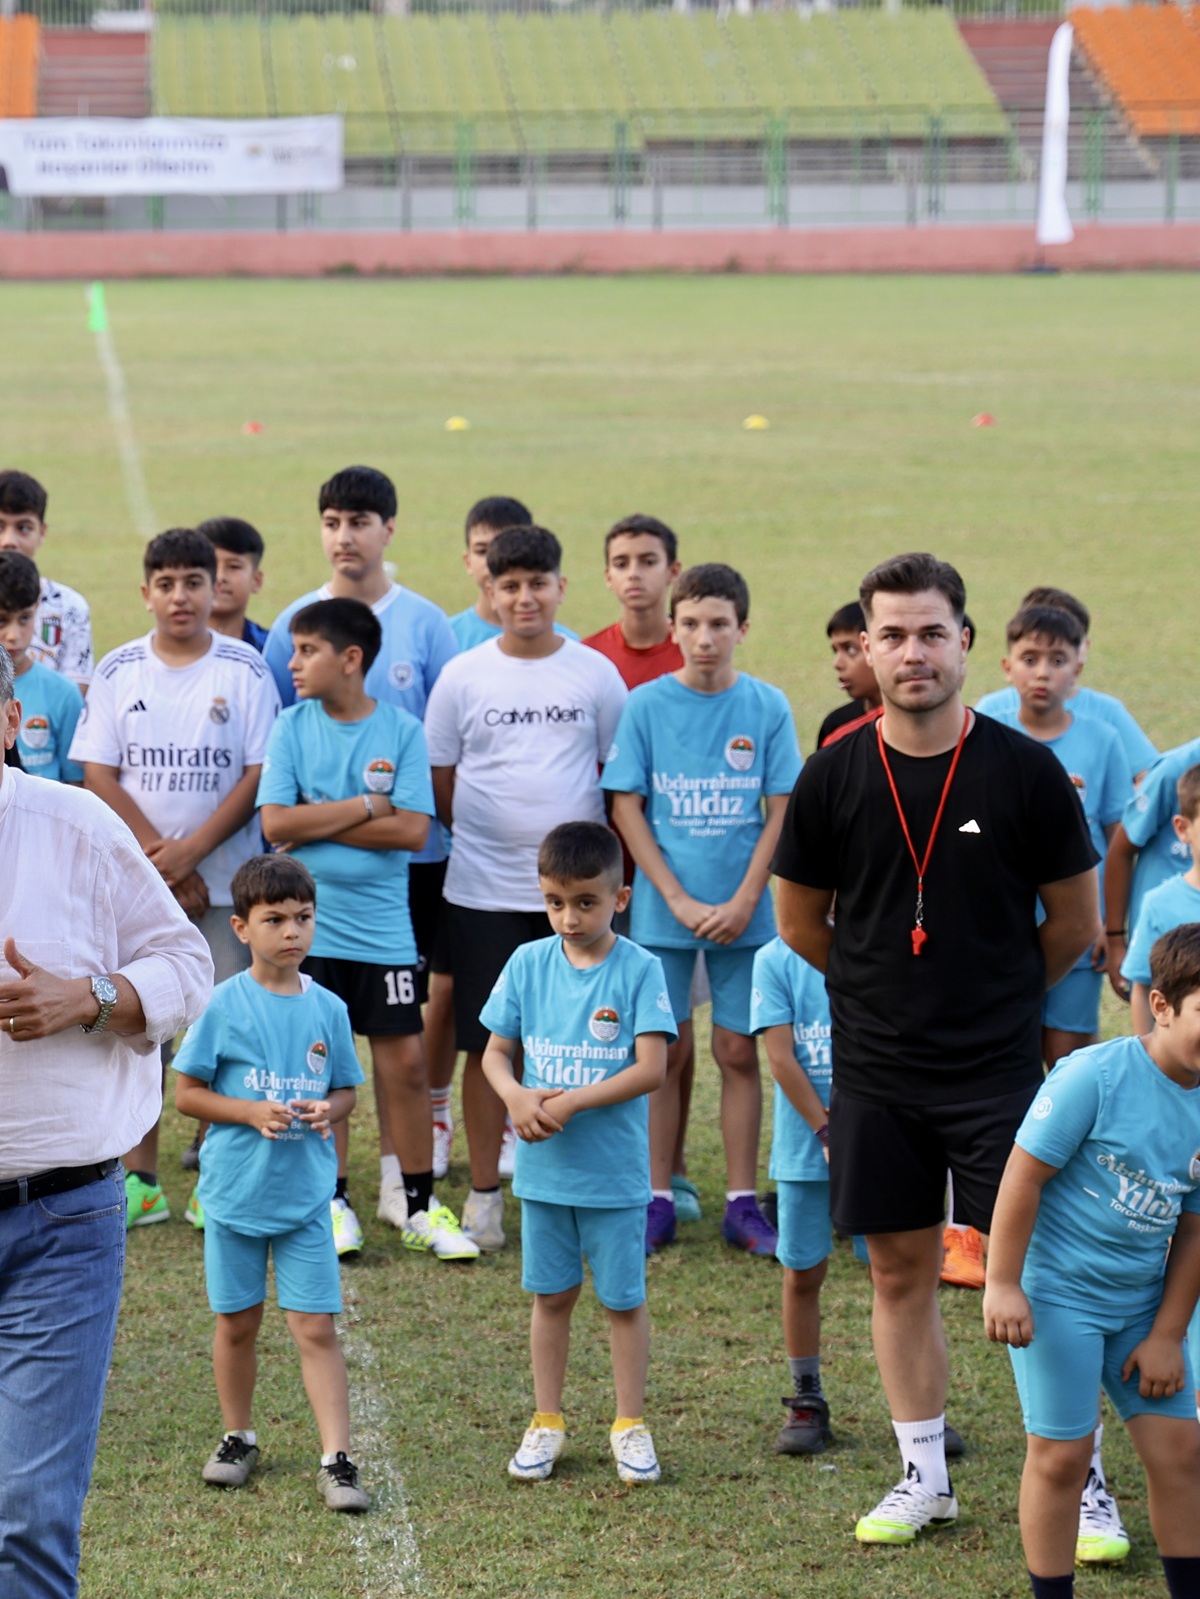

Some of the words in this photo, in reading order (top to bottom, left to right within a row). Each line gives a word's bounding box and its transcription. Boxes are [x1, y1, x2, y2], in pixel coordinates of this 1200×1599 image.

[545, 706, 586, 723] Klein
[127, 743, 233, 768] Emirates
[141, 772, 164, 792] FLY
[168, 772, 220, 793] BETTER
[384, 970, 415, 1005] 16
